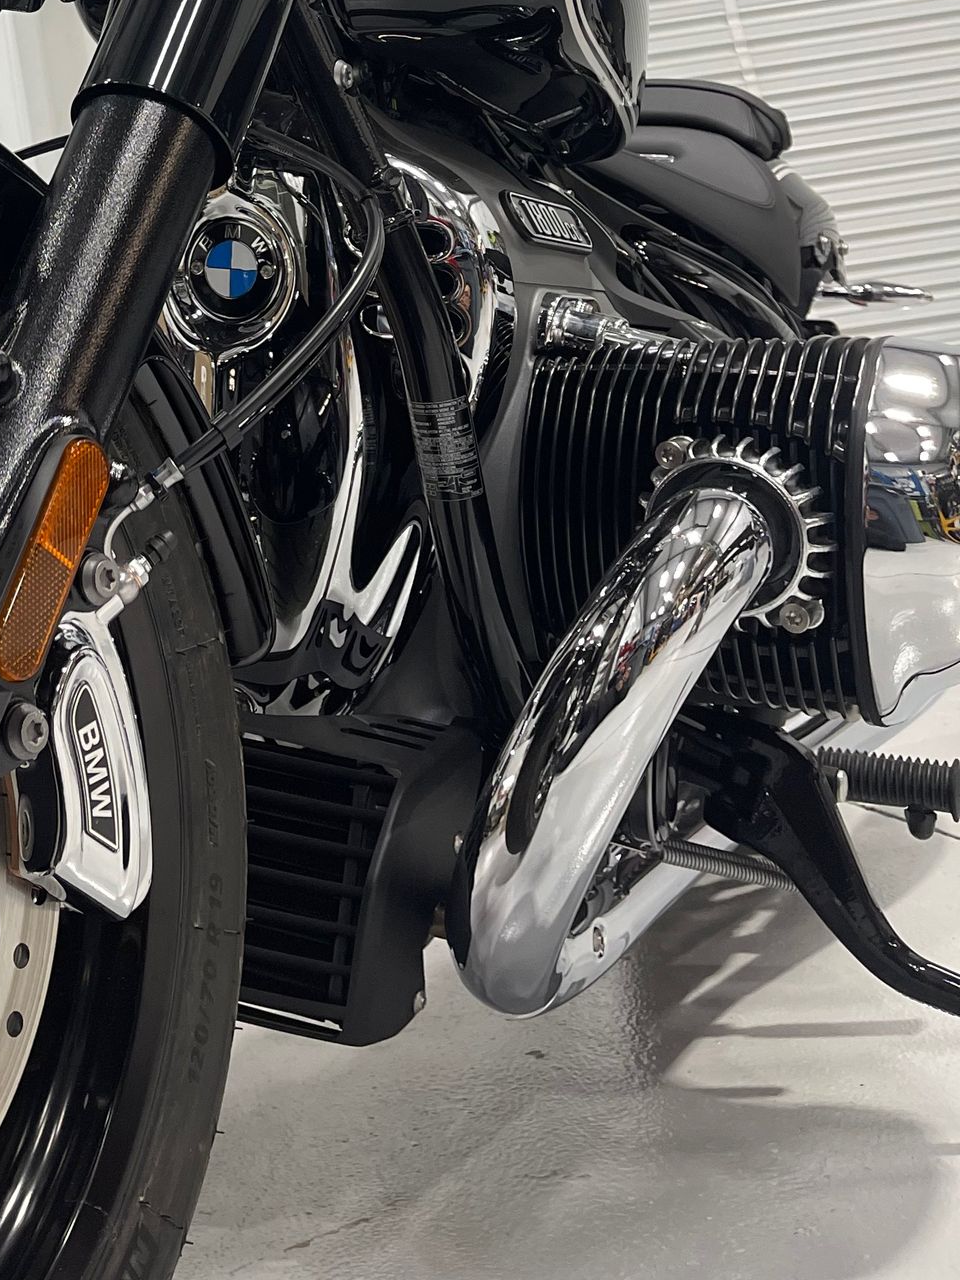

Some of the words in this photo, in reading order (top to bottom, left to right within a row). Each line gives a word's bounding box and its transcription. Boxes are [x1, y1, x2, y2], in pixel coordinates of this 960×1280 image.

[197, 224, 268, 256] BMW
[78, 719, 113, 818] BMW
[207, 873, 223, 910] 19
